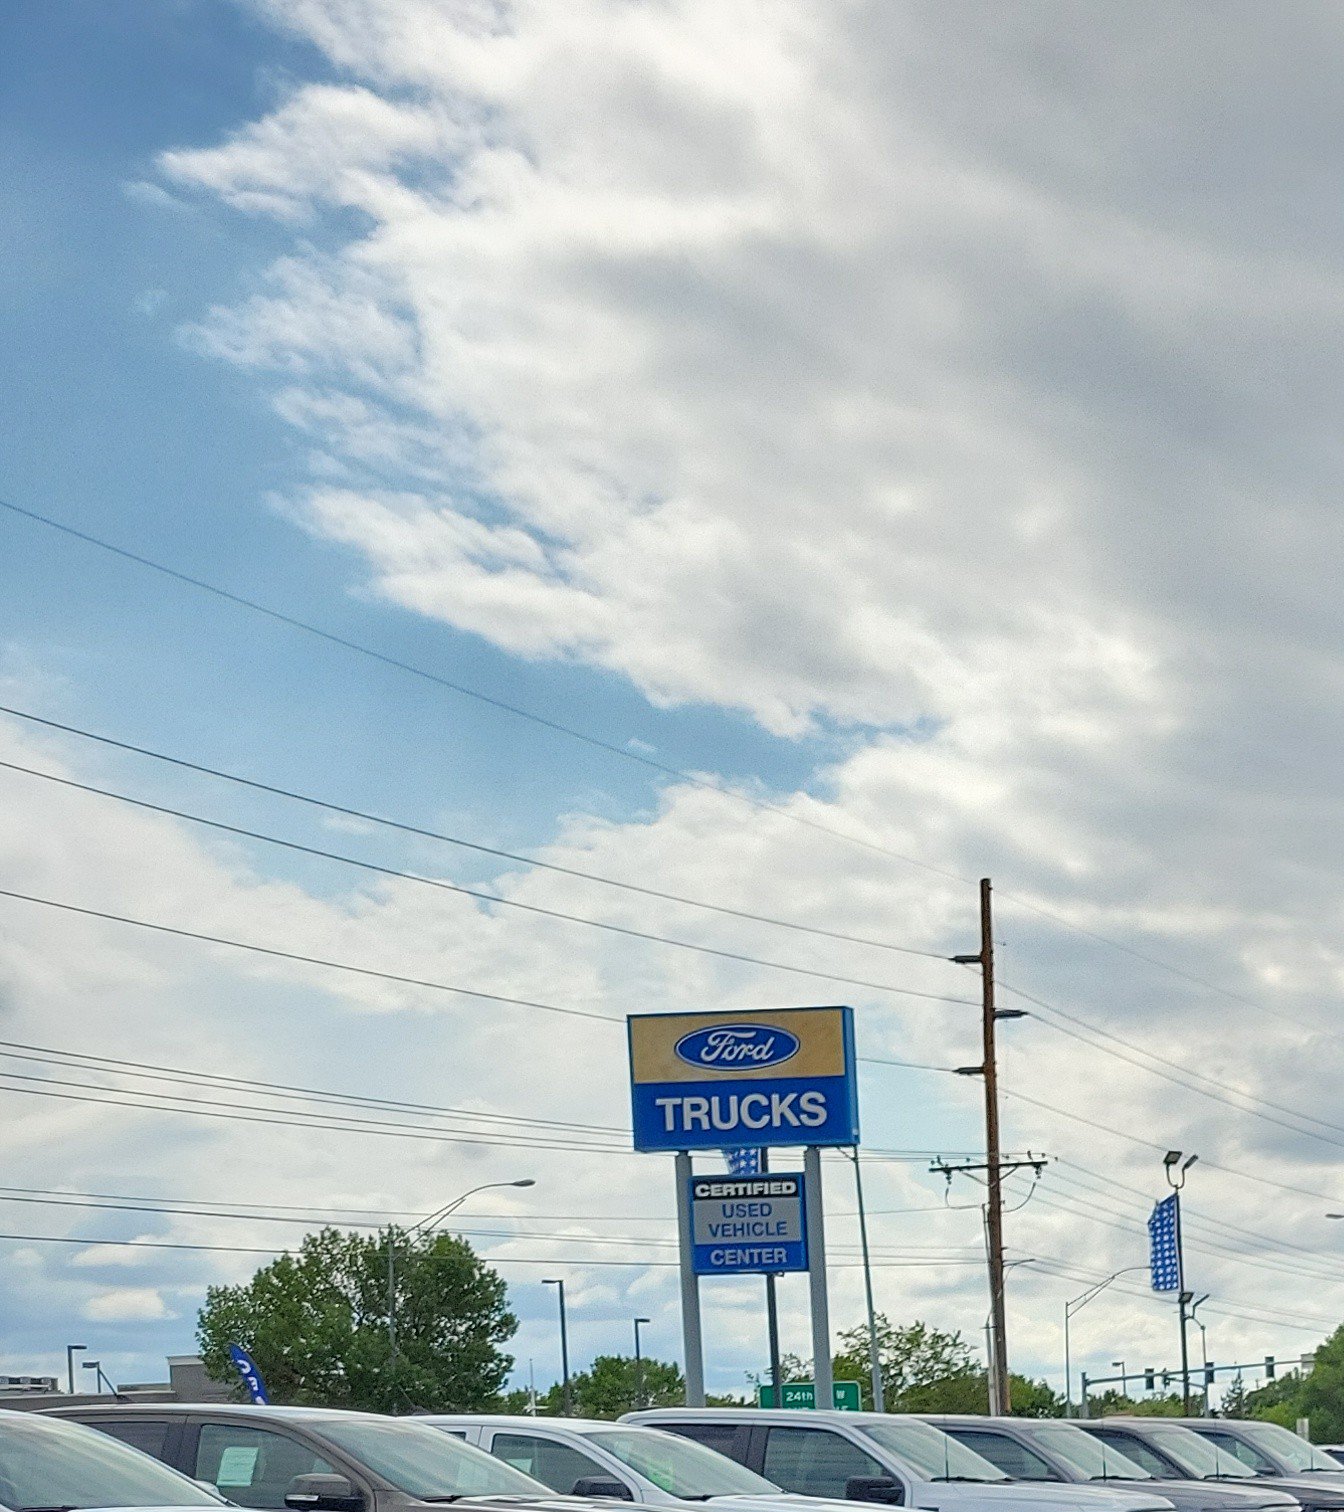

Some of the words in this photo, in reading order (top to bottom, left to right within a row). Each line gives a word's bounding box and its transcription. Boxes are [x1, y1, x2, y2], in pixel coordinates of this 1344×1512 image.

[700, 1030, 775, 1062] Ford
[656, 1092, 827, 1131] TRUCKS
[695, 1181, 796, 1197] CERTIFIED
[722, 1202, 772, 1218] USED
[709, 1221, 788, 1238] VEHICLE
[710, 1248, 787, 1265] CENTER
[786, 1391, 813, 1402] 24th
